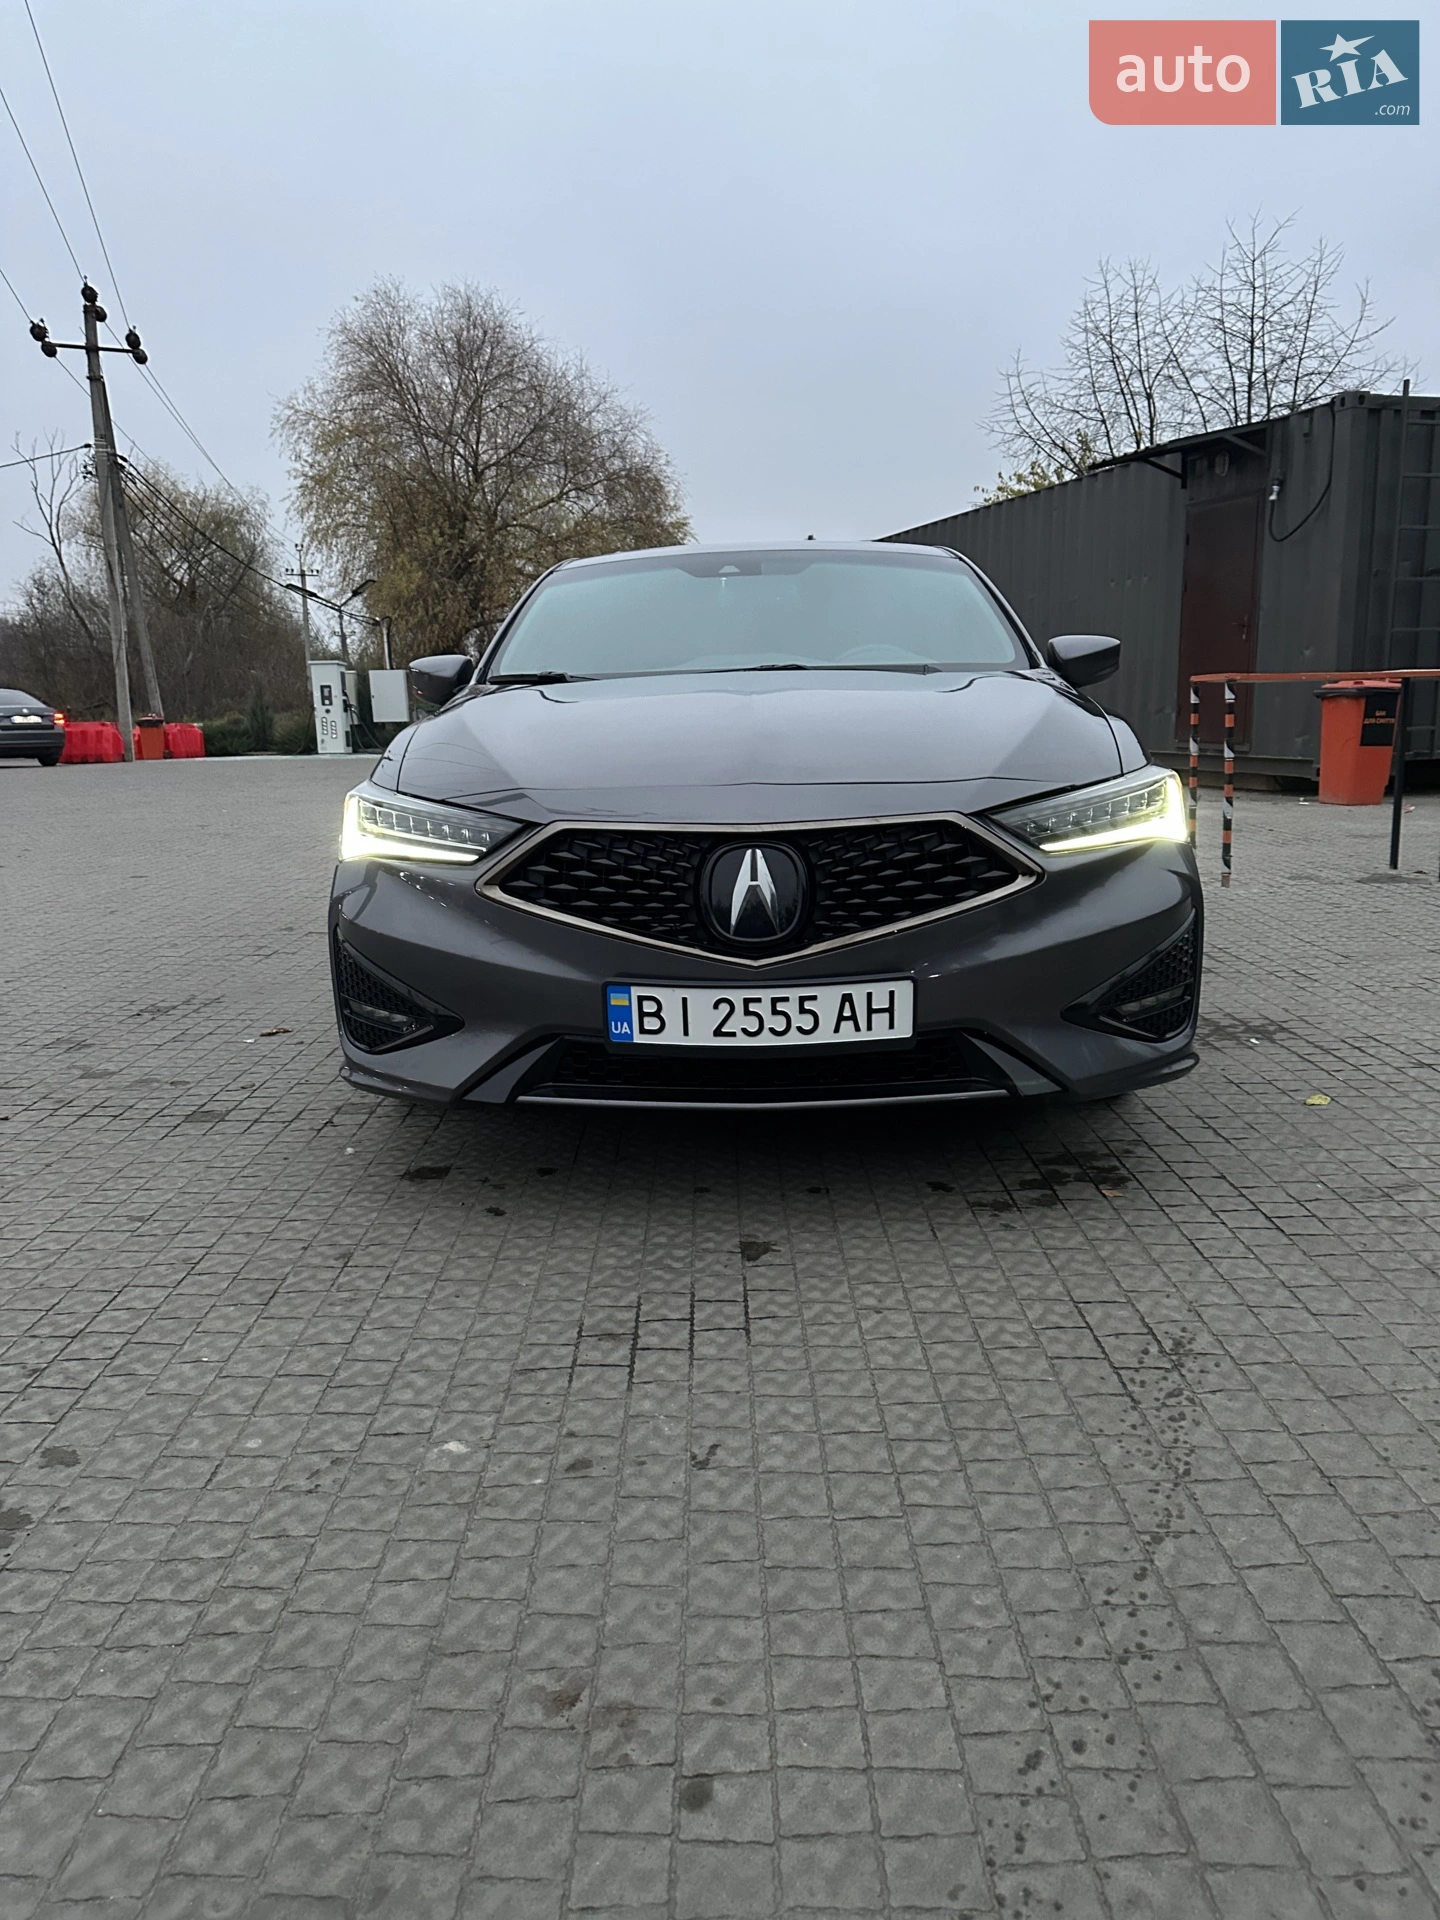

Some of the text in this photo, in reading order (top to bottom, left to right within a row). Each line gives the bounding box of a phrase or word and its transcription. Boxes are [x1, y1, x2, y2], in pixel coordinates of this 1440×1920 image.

[611, 1021, 631, 1035] UA
[636, 989, 895, 1037] BI 2555 AH
